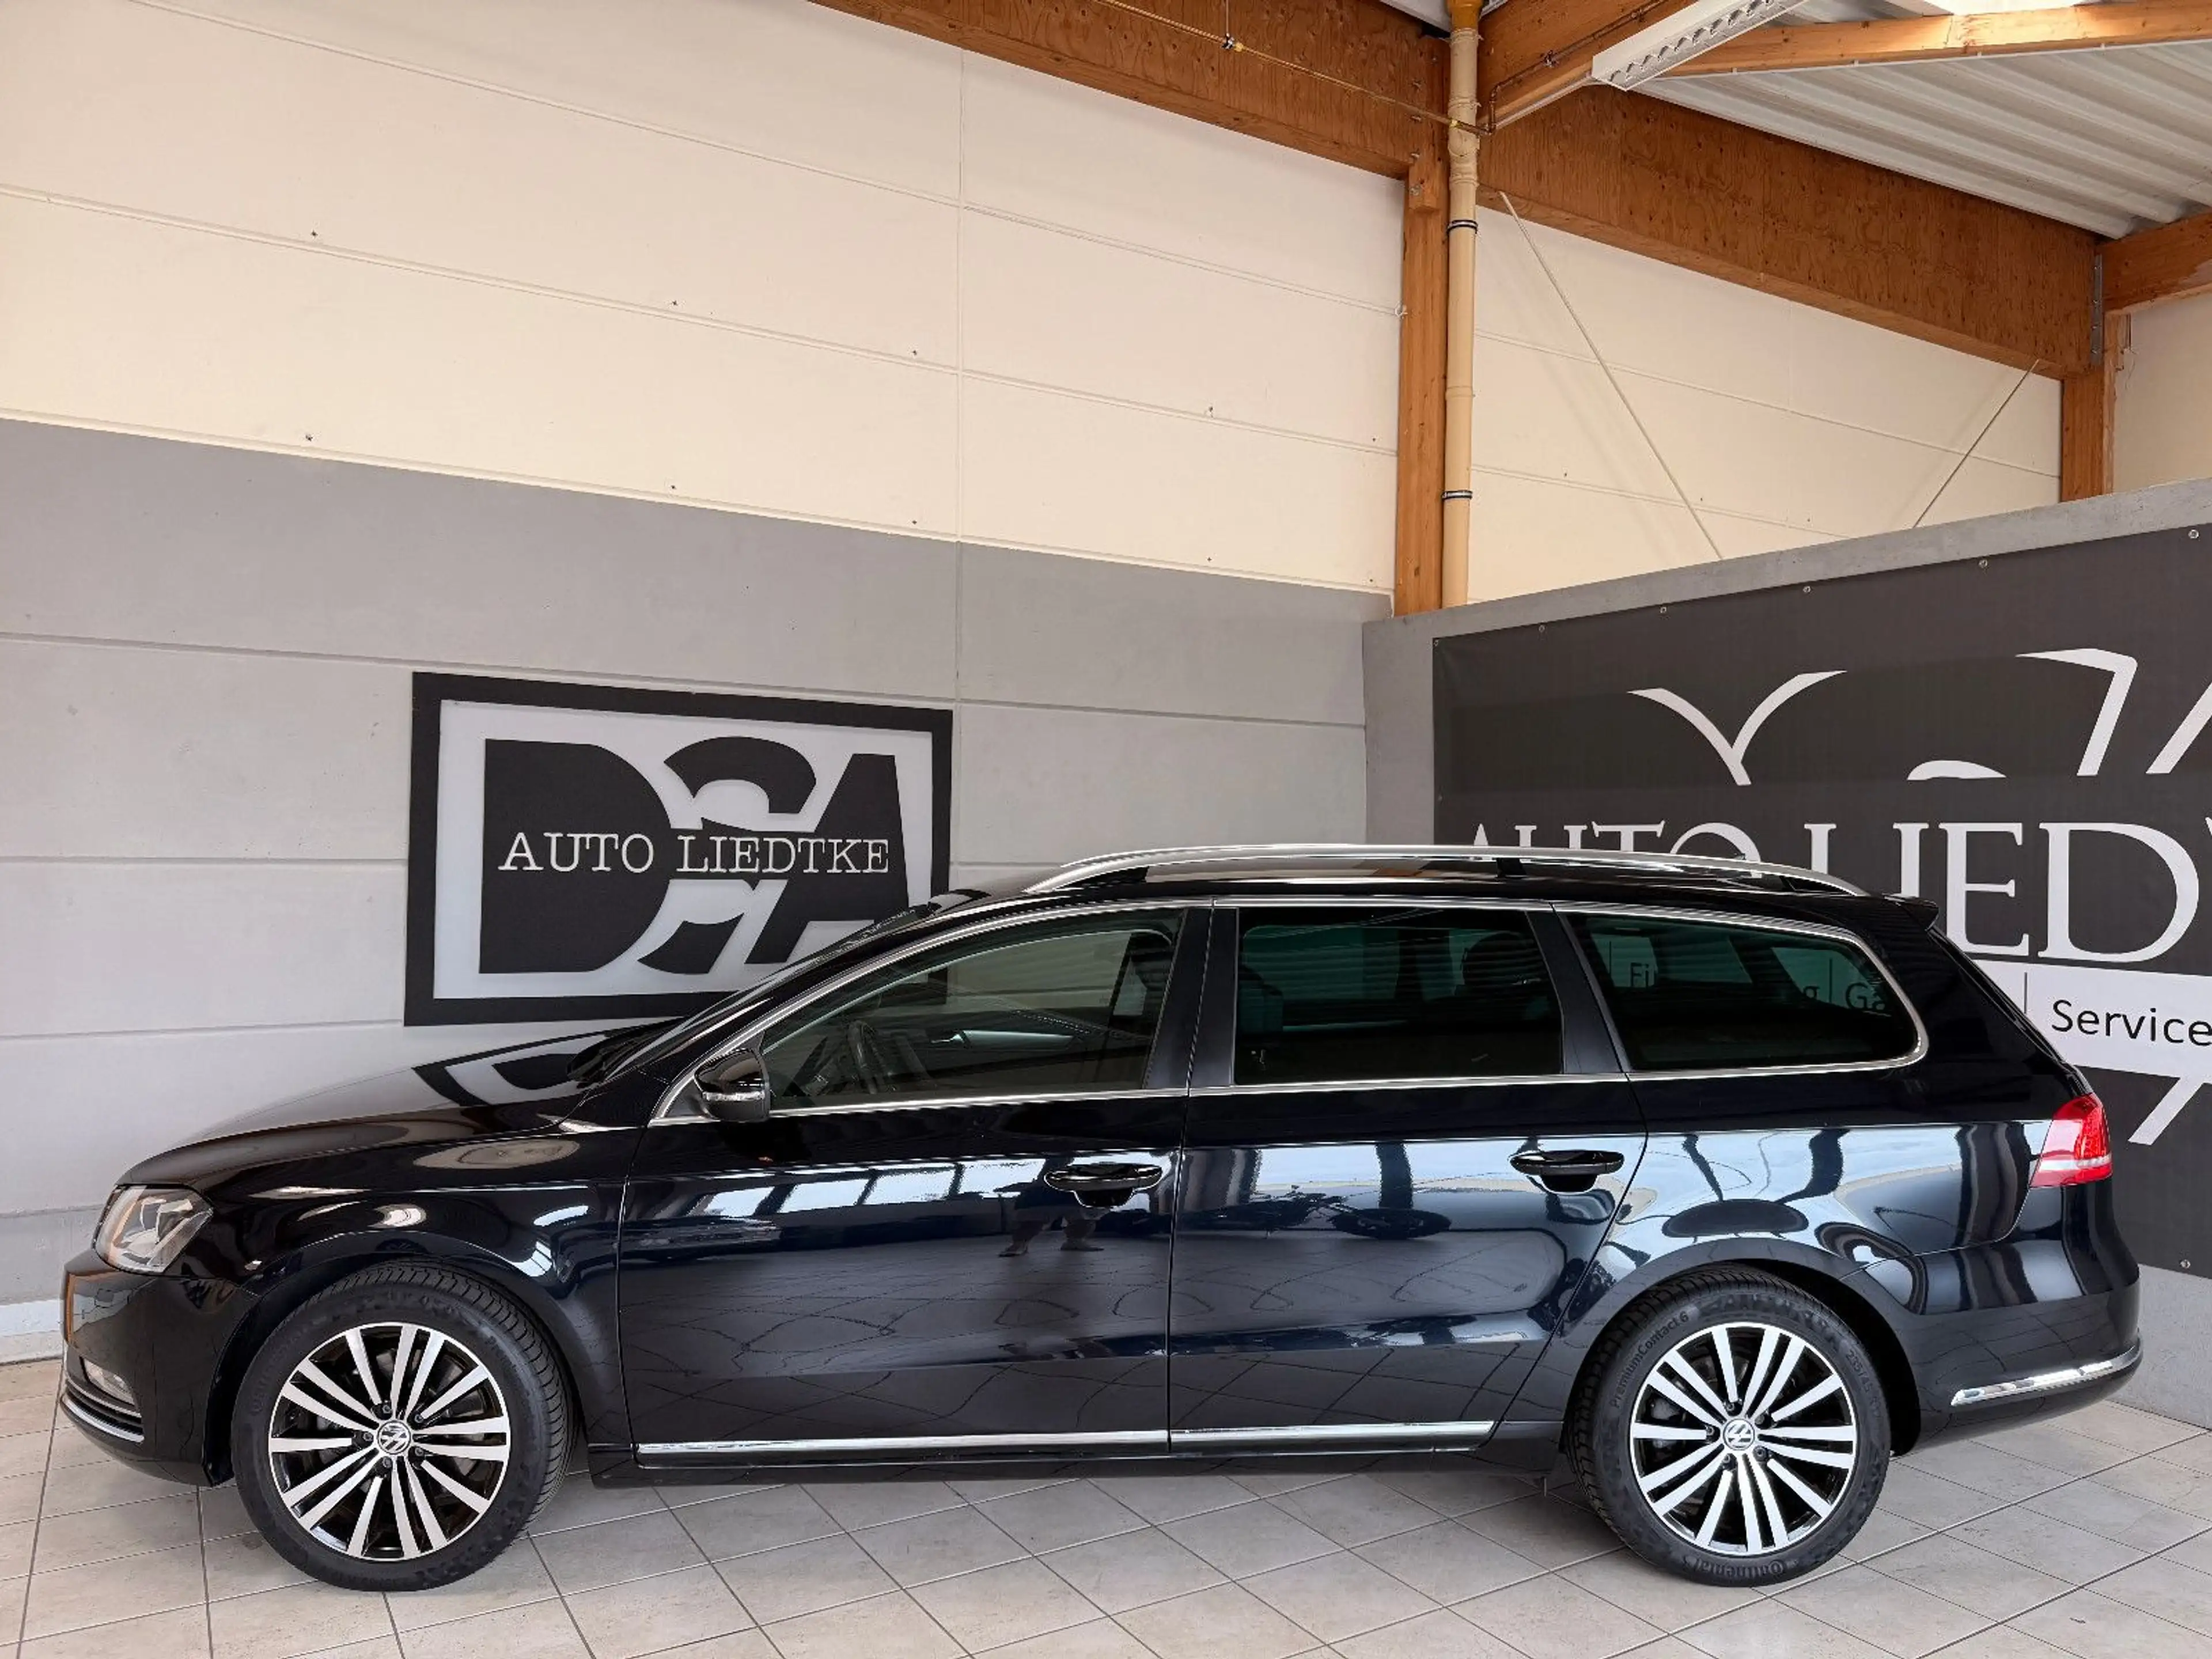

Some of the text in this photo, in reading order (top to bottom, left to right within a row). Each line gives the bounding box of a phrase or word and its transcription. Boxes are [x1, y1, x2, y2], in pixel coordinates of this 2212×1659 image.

[497, 832, 889, 874] AUTO LIEDTKE
[2051, 999, 2212, 1047] Service
